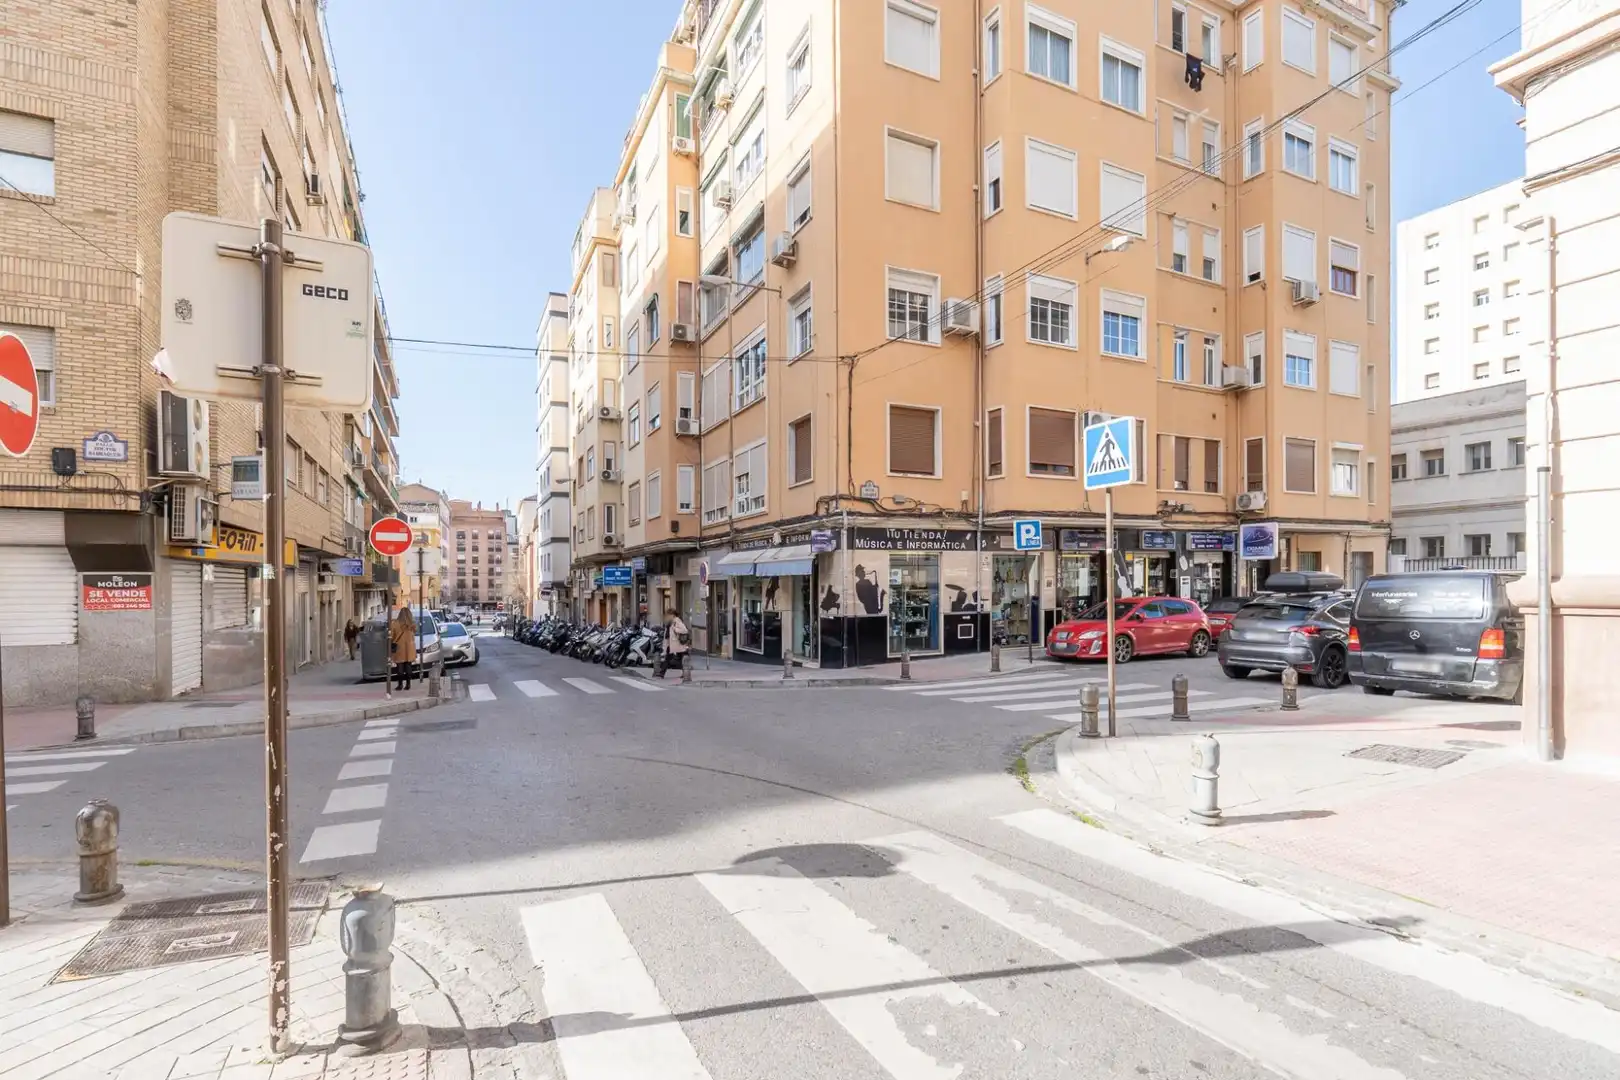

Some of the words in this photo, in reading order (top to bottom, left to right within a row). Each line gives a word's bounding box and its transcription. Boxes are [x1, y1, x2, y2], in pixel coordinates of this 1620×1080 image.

[855, 537, 893, 549] MÚSICA
[897, 541, 903, 549] E
[906, 539, 966, 550] INFORMÁTICA
[89, 590, 104, 598] SE
[106, 589, 147, 598] VENDE
